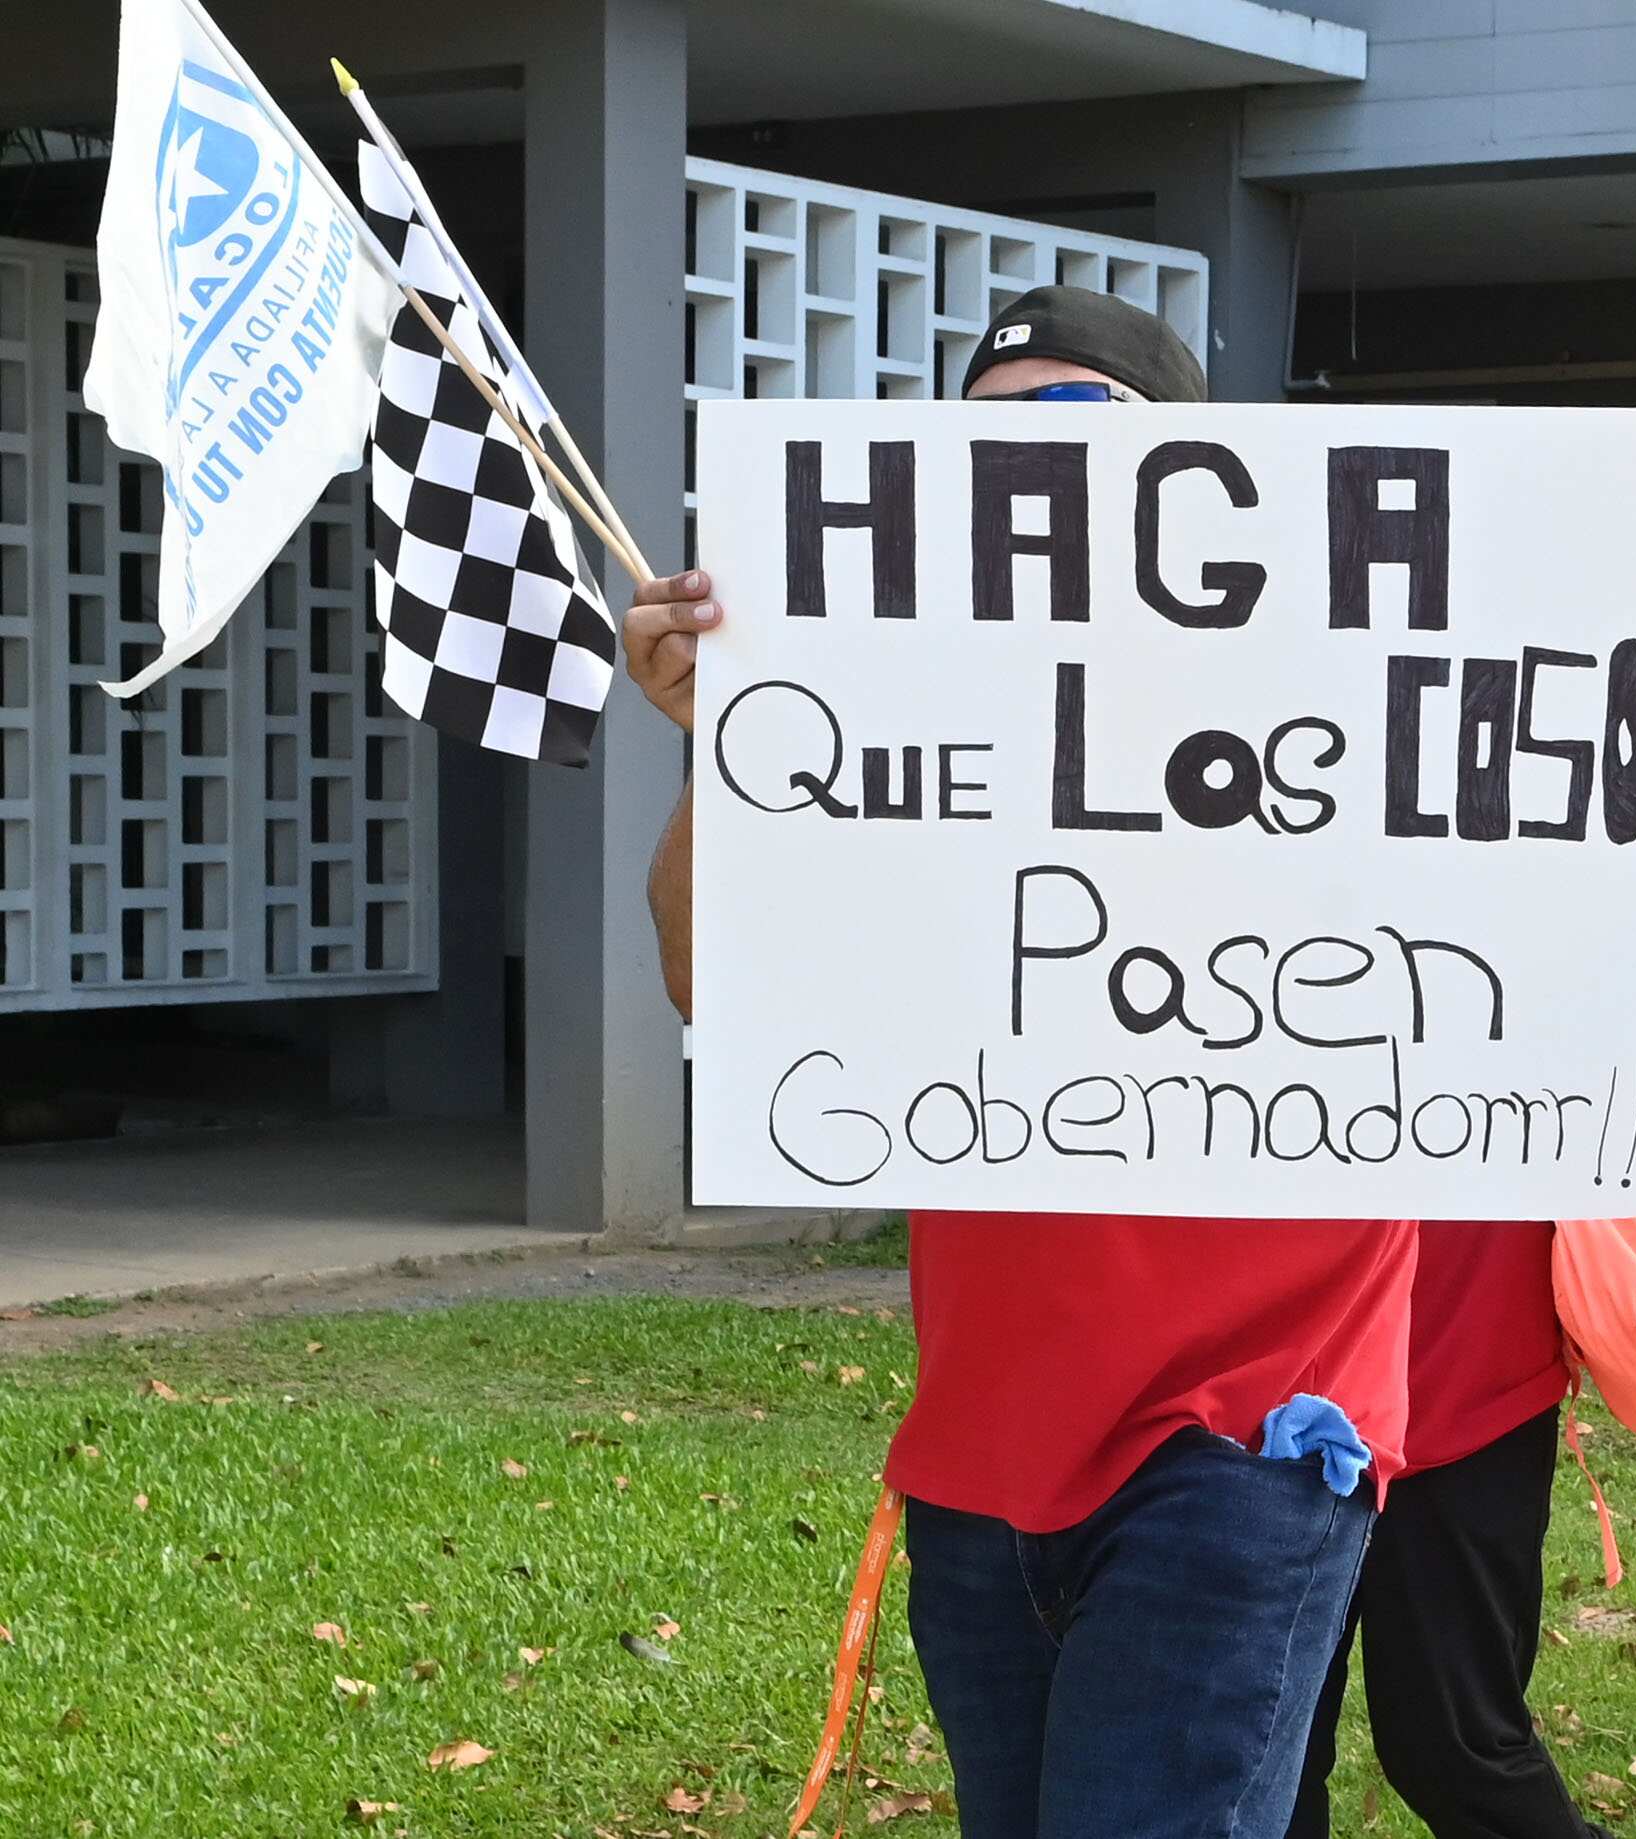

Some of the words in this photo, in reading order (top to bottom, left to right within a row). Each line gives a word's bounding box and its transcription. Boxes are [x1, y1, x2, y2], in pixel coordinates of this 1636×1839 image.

[785, 439, 1450, 632] HAGA
[1051, 662, 1347, 835] Las
[1011, 864, 1503, 1050] Pasen
